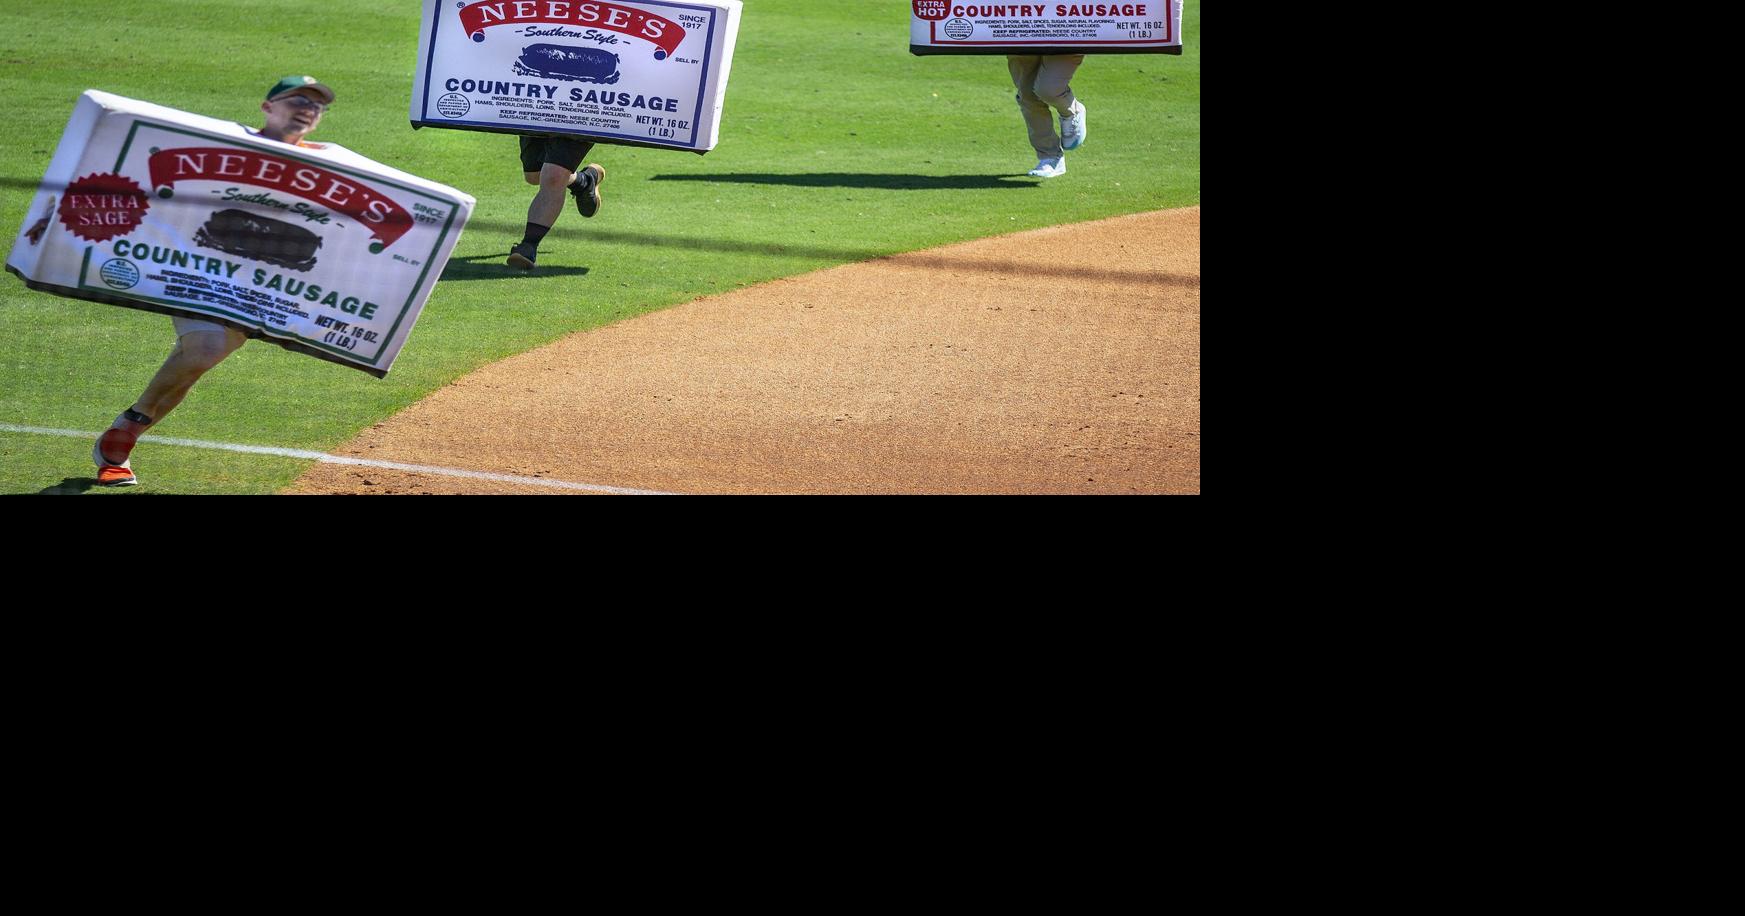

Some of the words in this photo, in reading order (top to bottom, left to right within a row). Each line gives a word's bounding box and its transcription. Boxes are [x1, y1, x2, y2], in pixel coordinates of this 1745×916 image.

[917, 0, 945, 8] EXTRA
[953, 5, 1046, 17] COUNTRY
[1056, 5, 1147, 17] SAUSAGE
[678, 14, 706, 23] SINCE
[918, 8, 946, 17] HOT
[478, 1, 667, 39] NEESE'S
[681, 22, 702, 30] 1917
[1116, 22, 1129, 30] NET
[582, 29, 618, 45] Style
[1138, 30, 1152, 39] LB.)
[675, 56, 690, 64] SELL
[445, 78, 558, 99] COUNTRY
[569, 88, 679, 113] SAUSAGE
[590, 116, 621, 125] COUNTRY
[635, 115, 651, 125] NET
[651, 116, 664, 127] WT.
[667, 118, 676, 128] 16
[677, 120, 690, 130] OZ.
[648, 126, 657, 136] (1
[658, 127, 675, 139] LB.)
[174, 153, 393, 223] NEESE'S
[70, 194, 139, 209] EXTRA
[412, 202, 446, 219] SINCE
[79, 211, 131, 226] SAGE
[414, 213, 438, 225] 1917
[113, 239, 242, 279] COUNTRY
[252, 268, 379, 321] SAUSAGE
[314, 314, 336, 329] NET
[333, 319, 350, 334] WT.
[350, 325, 365, 339] 16
[336, 333, 358, 351] LB.)
